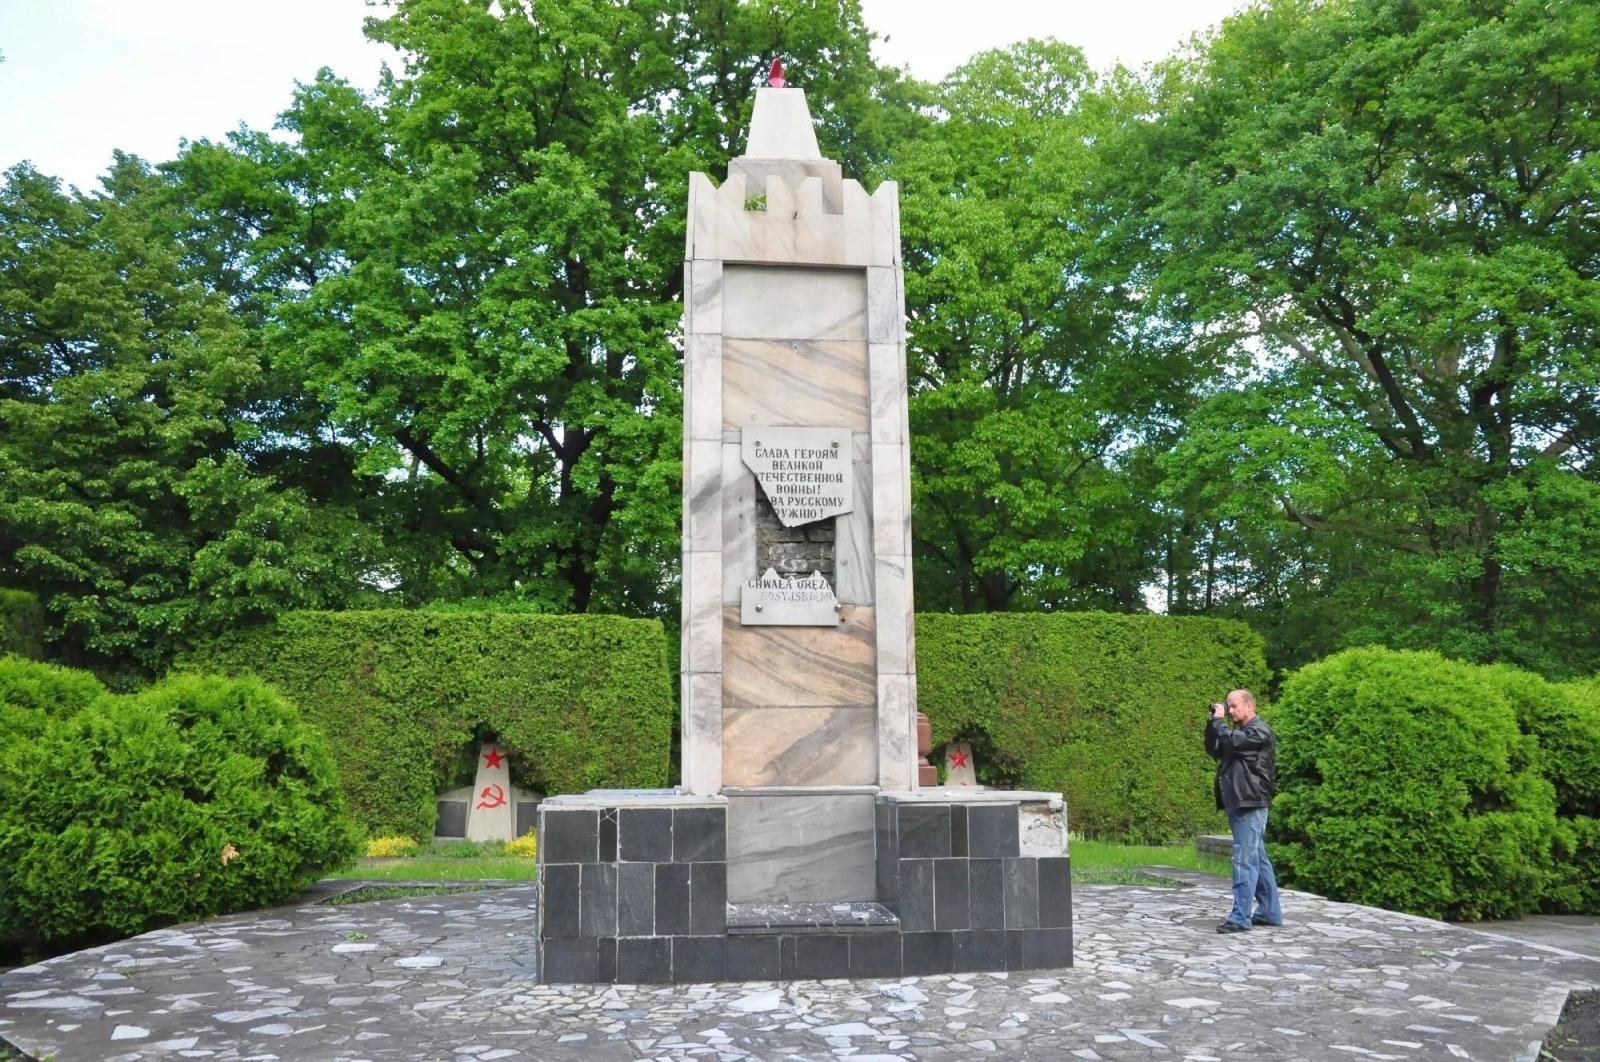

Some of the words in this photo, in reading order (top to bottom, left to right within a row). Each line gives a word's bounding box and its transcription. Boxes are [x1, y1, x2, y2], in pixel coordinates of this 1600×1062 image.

[755, 448, 790, 459] СЛАВА
[794, 448, 839, 460] ГЕРОЯМ
[776, 484, 821, 495] ВОЙНЫ!
[787, 496, 844, 507] РУССКОМУ
